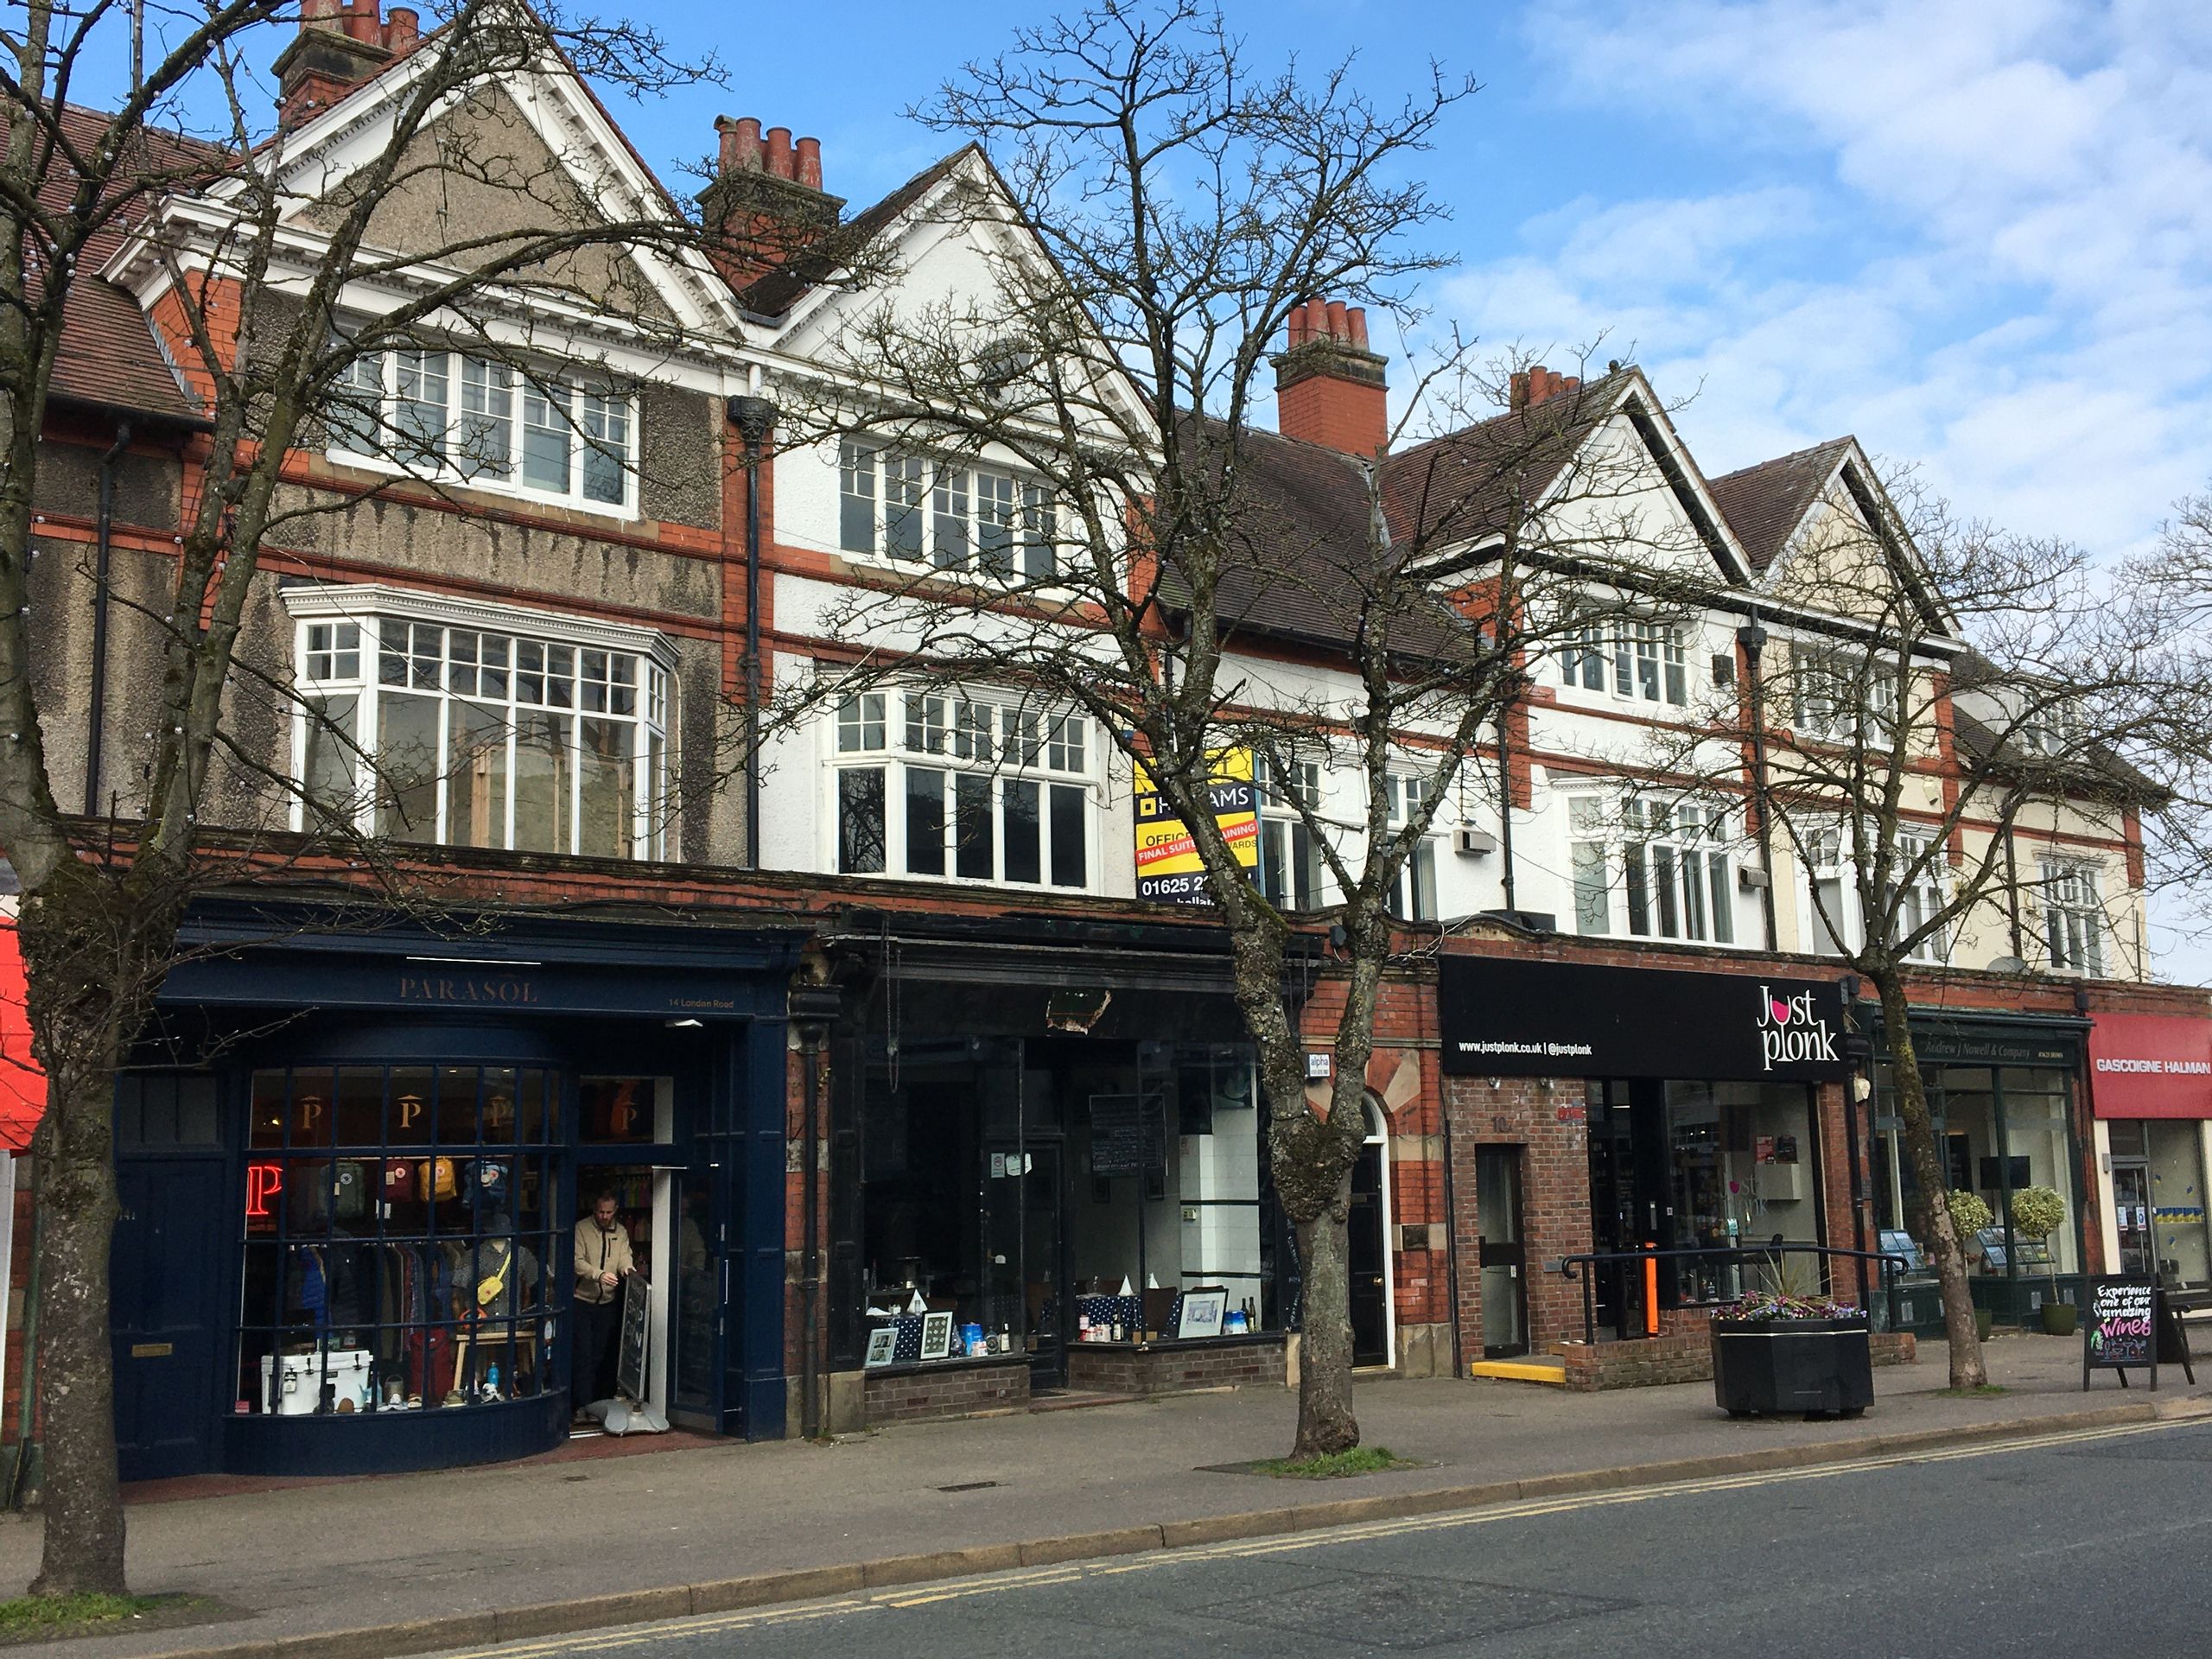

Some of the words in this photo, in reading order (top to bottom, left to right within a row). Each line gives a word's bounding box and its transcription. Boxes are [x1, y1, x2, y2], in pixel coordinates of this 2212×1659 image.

[1159, 787, 1249, 814] HAMS
[1138, 847, 1168, 861] FINAL
[1142, 877, 1190, 896] 01625
[399, 977, 538, 1002] PARASOL
[681, 998, 712, 1007] London
[713, 999, 734, 1008] Road
[1757, 985, 1817, 1027] Just
[1459, 1040, 1542, 1054] www.justplonk.co.uk
[1548, 1042, 1592, 1056] @justplonk
[1761, 1020, 1840, 1071] plonk
[1963, 1042, 1988, 1056] Nowell
[1990, 1044, 1997, 1056] &
[1998, 1044, 2031, 1060] Company
[1310, 1056, 1329, 1068] alpha
[2096, 1058, 2163, 1073] GASCOIGNE
[2164, 1060, 2211, 1074] HALMAN
[399, 1103, 422, 1128] P
[247, 1166, 283, 1216] P
[2097, 1284, 2152, 1300] Experience
[2101, 1298, 2120, 1307] one
[2122, 1296, 2133, 1310] of
[2134, 1296, 2152, 1306] our
[2102, 1306, 2152, 1323] amazing
[2100, 1318, 2152, 1338] Wines
